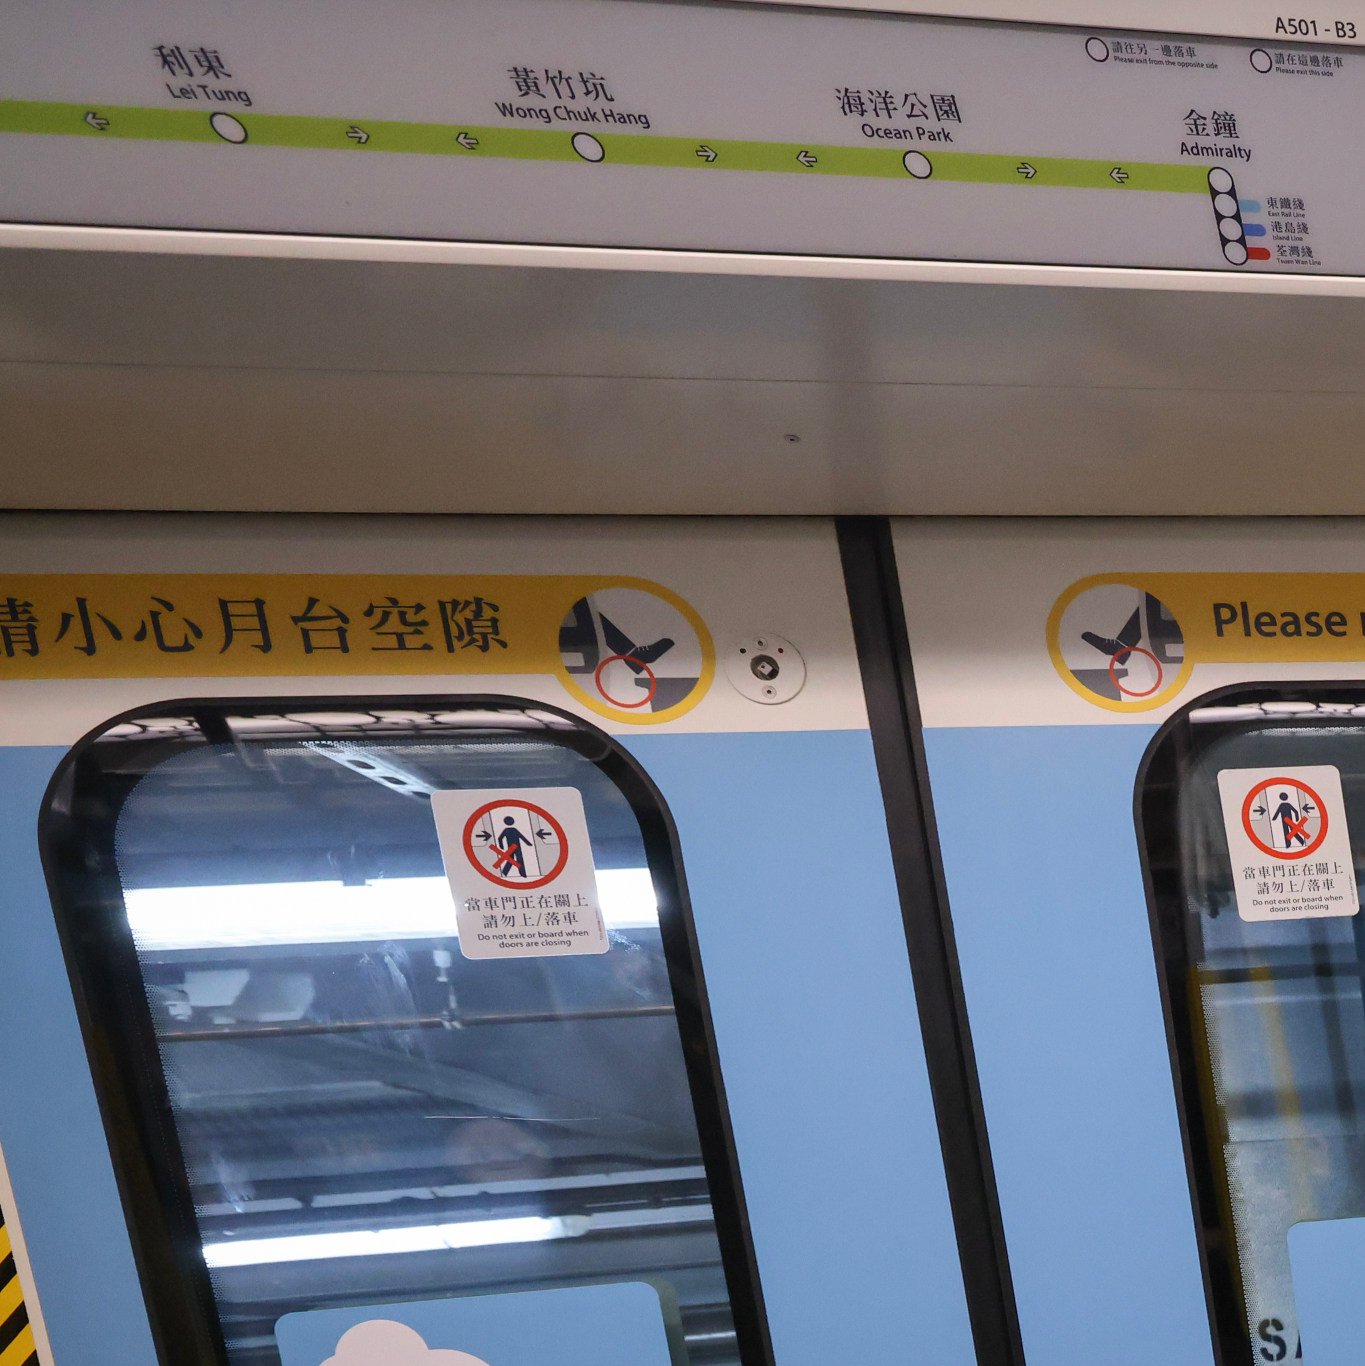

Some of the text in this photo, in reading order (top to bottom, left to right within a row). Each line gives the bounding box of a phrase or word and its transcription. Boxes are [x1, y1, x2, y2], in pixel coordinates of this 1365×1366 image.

[1275, 17, 1318, 36] A501
[1335, 21, 1357, 39] B3
[152, 45, 232, 79] 利東
[165, 81, 252, 107] Lei Tung
[506, 66, 615, 102] 黃竹坑
[494, 102, 651, 129] Wong Chuk Hang
[835, 87, 962, 124] 海洋公園
[861, 123, 953, 143] Ocean Park
[1182, 109, 1240, 139] 金鐘
[1180, 142, 1251, 163] Admiralty
[1212, 601, 1348, 638] Please
[1243, 862, 1343, 880] 當車門正在關上
[1257, 878, 1335, 895] 請勿上/落車
[465, 893, 588, 912] 當車門正在關上
[1270, 905, 1290, 913] doors
[1304, 904, 1329, 912] closing
[1302, 895, 1323, 903] board
[483, 911, 578, 929] 請勿上/落車
[478, 933, 490, 941] Do
[492, 932, 507, 940] not
[509, 931, 525, 939] exit
[538, 930, 563, 938] board
[565, 929, 589, 937] when
[499, 940, 524, 948] doors
[541, 938, 572, 947] closing
